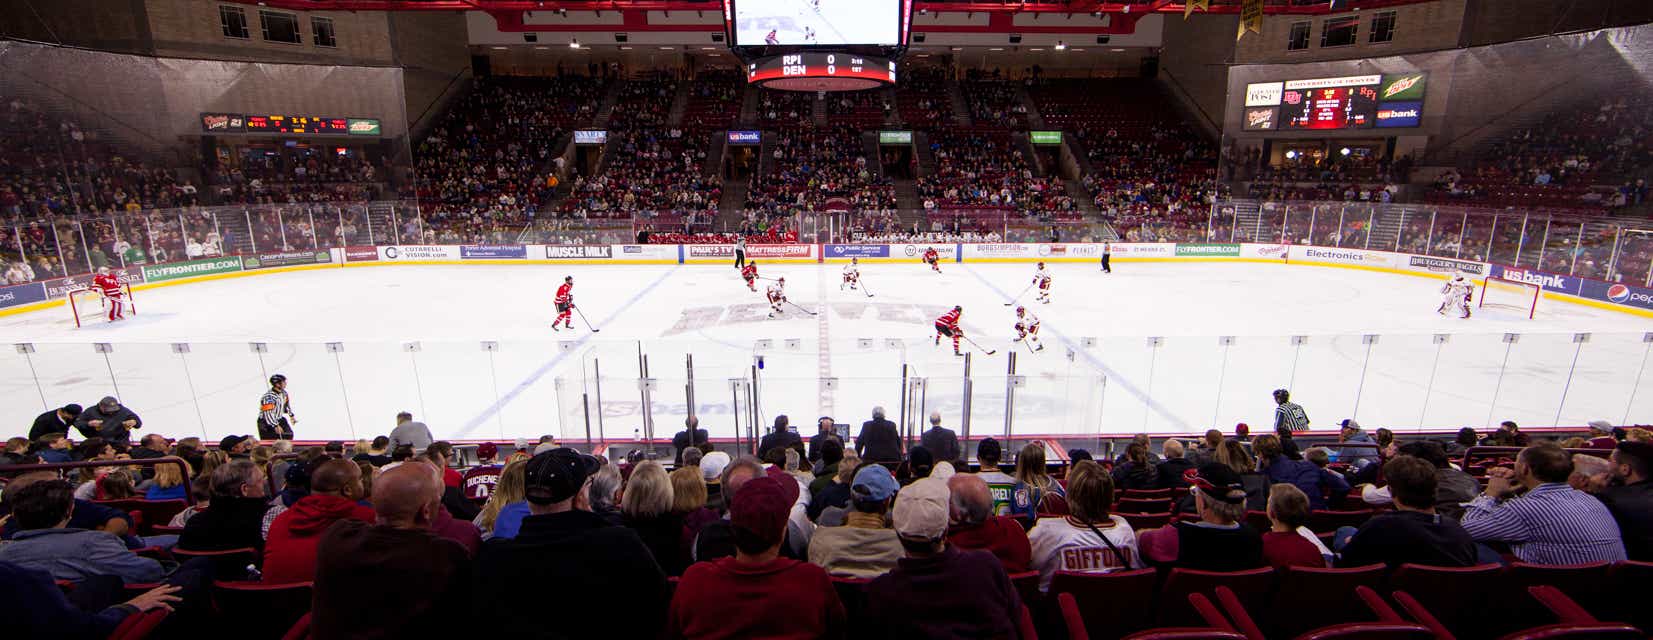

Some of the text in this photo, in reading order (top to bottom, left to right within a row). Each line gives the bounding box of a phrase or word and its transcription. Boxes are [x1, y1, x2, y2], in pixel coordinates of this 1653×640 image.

[783, 55, 801, 65] RPI
[827, 55, 835, 64] 0
[783, 65, 806, 75] DEN
[828, 65, 836, 74] 0
[1360, 86, 1377, 101] RPI
[1377, 109, 1418, 119] usbank
[728, 132, 758, 140] usbank
[547, 246, 609, 258] MUSCLE MILK
[691, 246, 720, 254] PAUL'S
[1306, 249, 1364, 261] Electronics
[146, 260, 239, 278] FLYFRONTIER.COM
[1502, 268, 1564, 288] usbank
[467, 474, 498, 487] DUCHENE
[1063, 546, 1132, 569] GIFFOD
